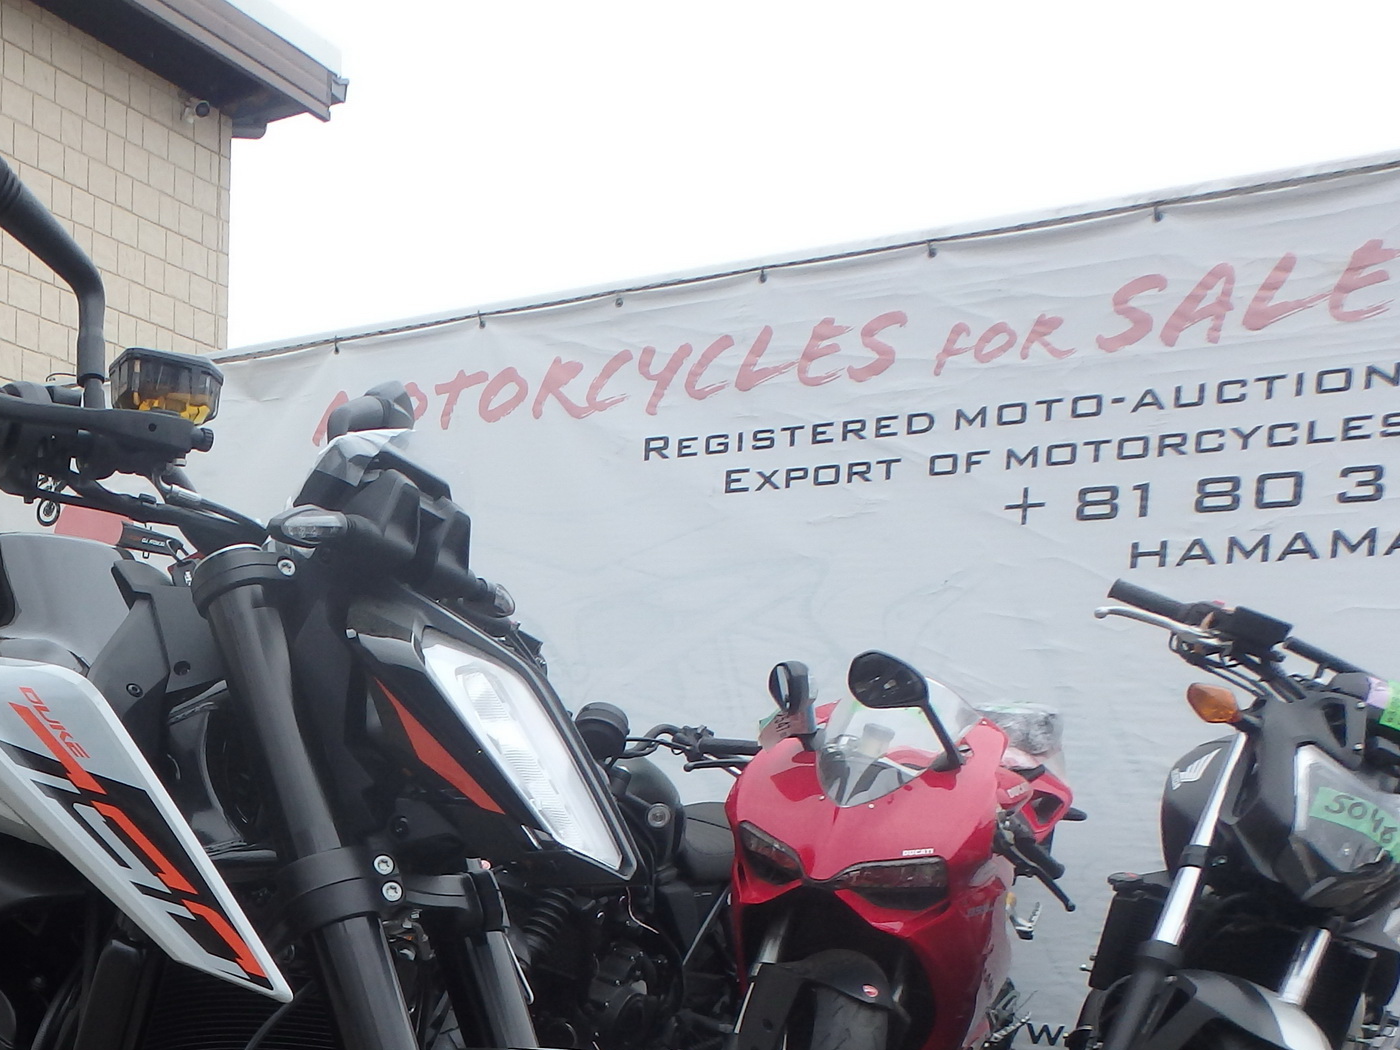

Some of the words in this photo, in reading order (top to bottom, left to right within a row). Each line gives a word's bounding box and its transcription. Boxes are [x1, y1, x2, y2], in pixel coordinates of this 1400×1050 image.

[1095, 239, 1400, 353] SALE
[643, 411, 936, 461] REGISTERED
[724, 457, 902, 494] EXPORT
[928, 449, 991, 477] OF
[1075, 482, 1151, 522] 81
[1194, 470, 1304, 514] 80
[18, 686, 92, 759] DUKE
